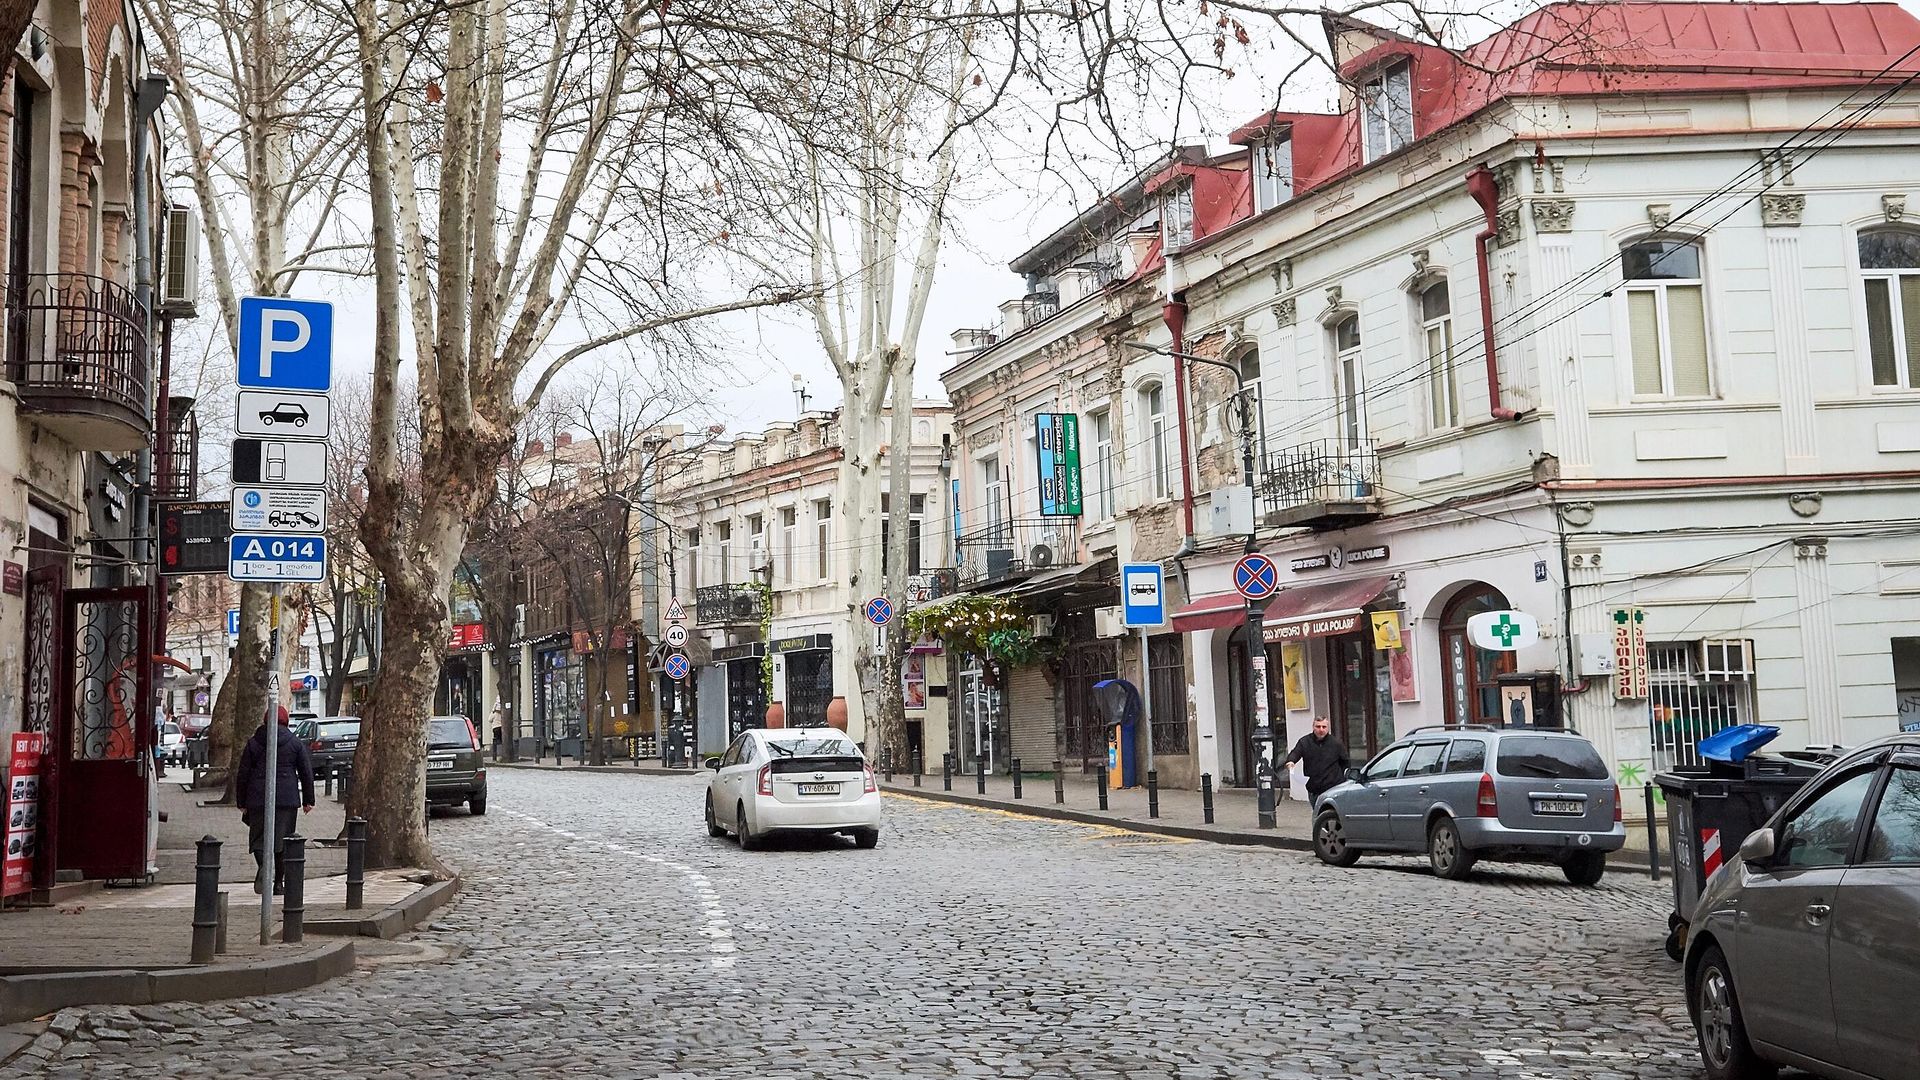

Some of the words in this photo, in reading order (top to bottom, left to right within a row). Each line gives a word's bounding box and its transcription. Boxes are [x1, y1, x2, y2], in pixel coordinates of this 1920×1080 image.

[259, 309, 312, 378] P
[1067, 421, 1076, 451] National
[242, 538, 266, 558] A
[271, 540, 315, 558] 014
[1347, 551, 1362, 562] LUCA
[1362, 547, 1385, 559] POLARE
[242, 562, 251, 575] 1
[276, 563, 285, 576] 1
[1535, 565, 1546, 577] 34
[1313, 621, 1329, 633] LUCA
[669, 631, 684, 640] 40
[1616, 627, 1631, 696] აფთიაქი
[1635, 627, 1646, 696] აფთიაქი
[16, 740, 28, 753] RENT
[1541, 801, 1578, 812] PN-100-CA
